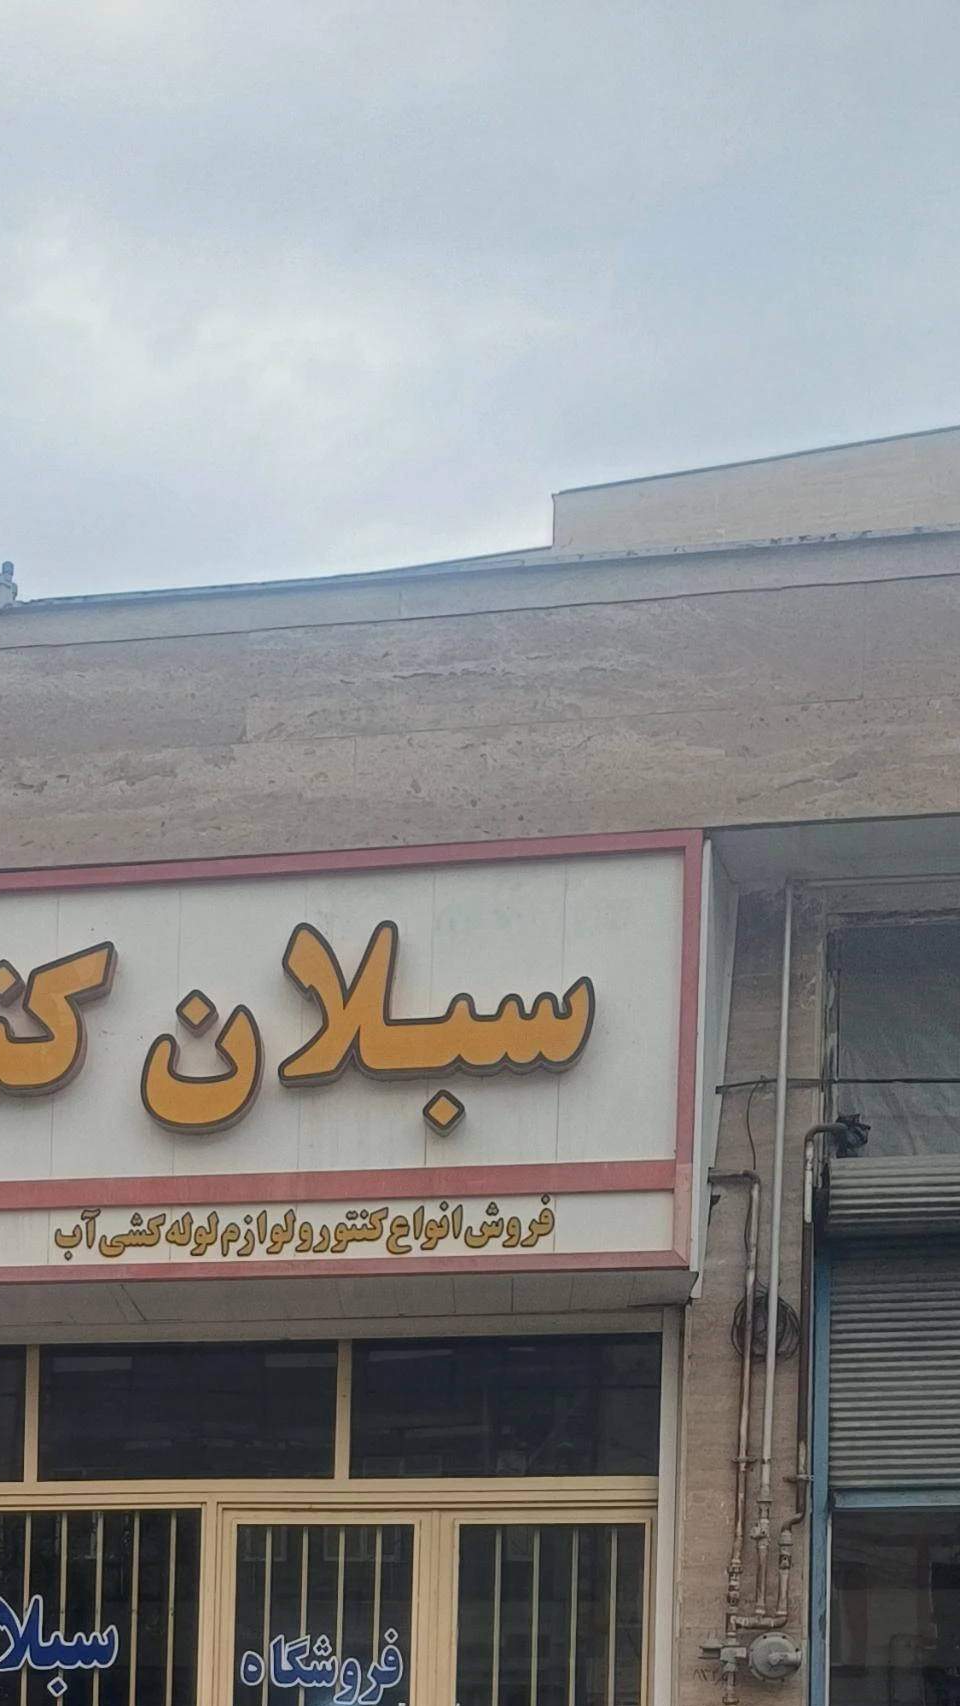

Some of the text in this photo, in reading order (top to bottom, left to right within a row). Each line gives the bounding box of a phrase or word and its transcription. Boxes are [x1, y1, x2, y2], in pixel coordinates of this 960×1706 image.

[140, 920, 596, 1136] سبلان
[54, 1208, 101, 1261] آب
[99, 1212, 166, 1257] کشی
[165, 1210, 220, 1256] لوله
[221, 1208, 297, 1256] لوازم
[312, 1206, 389, 1253] کنتور
[386, 1201, 463, 1255] انواع
[464, 1193, 555, 1248] فروش
[241, 1628, 404, 1705] فروشگاه
